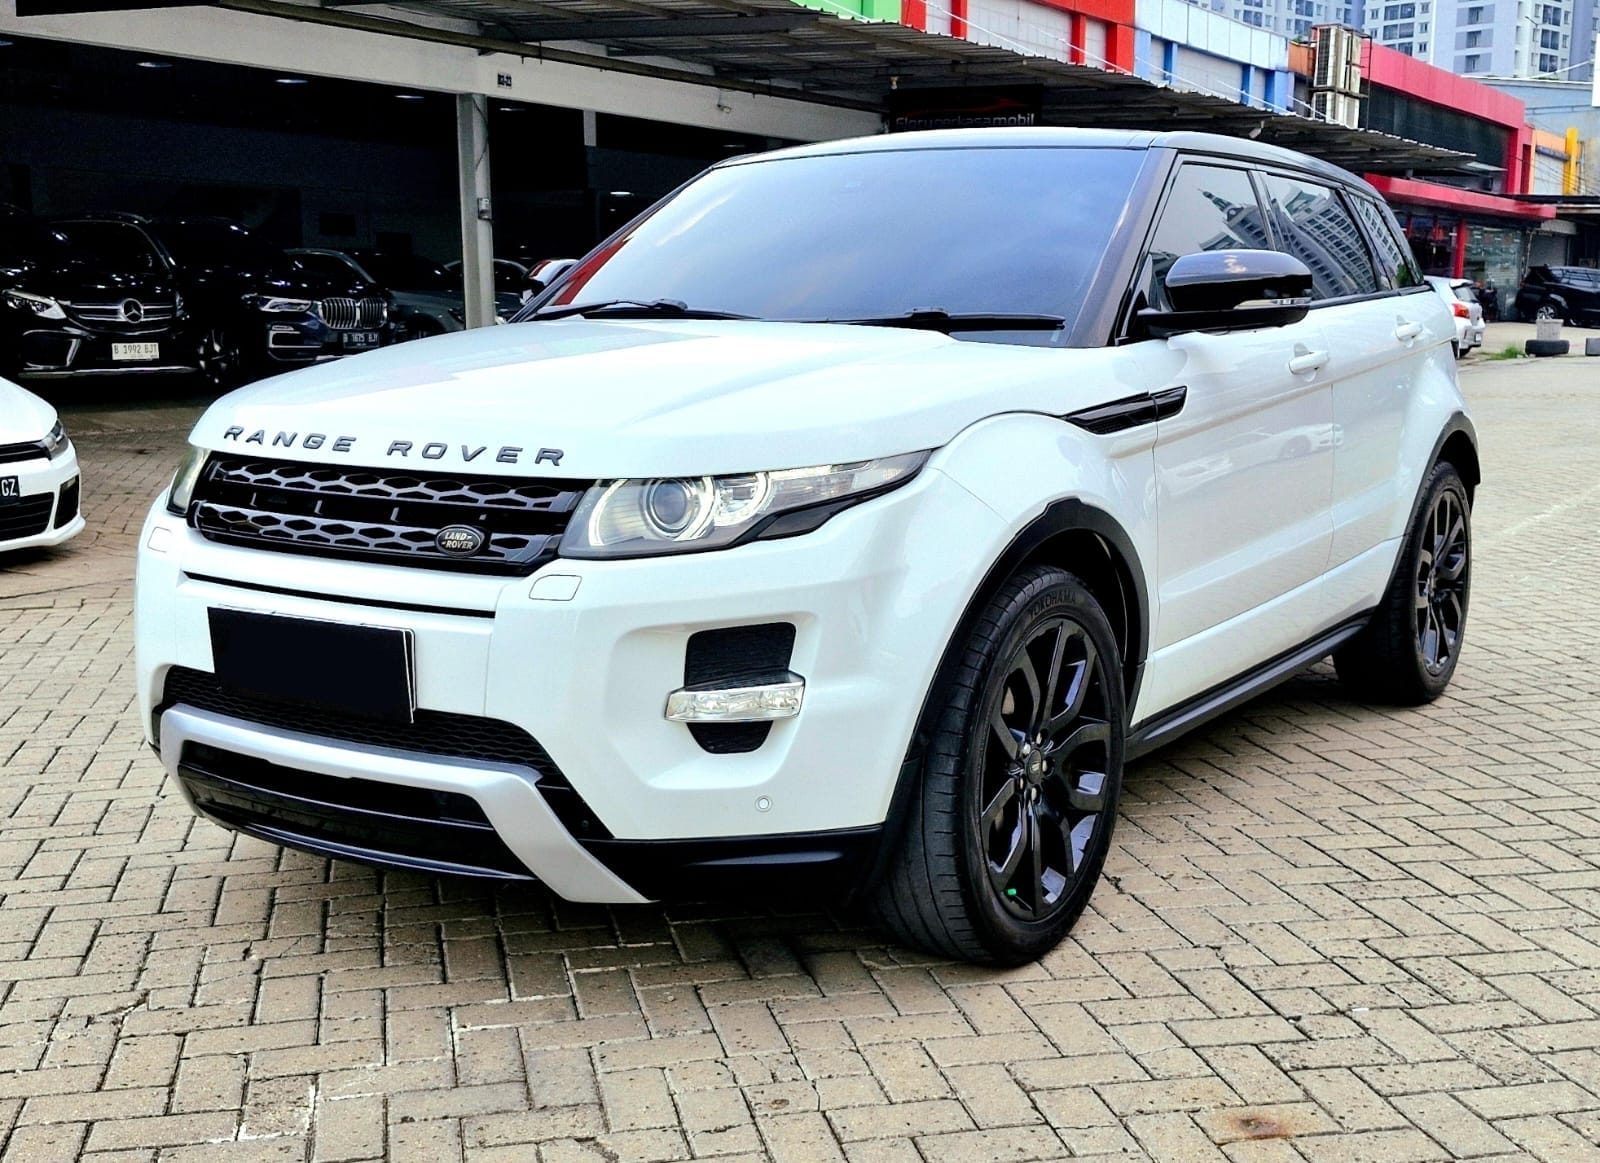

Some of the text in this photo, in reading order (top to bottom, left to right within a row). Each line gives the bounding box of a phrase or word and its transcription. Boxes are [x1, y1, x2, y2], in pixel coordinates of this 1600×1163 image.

[113, 344, 120, 354] B
[123, 344, 142, 354] 1992
[223, 425, 564, 466] RANGE ROVER
[1027, 588, 1078, 620] YOKOHAMA
